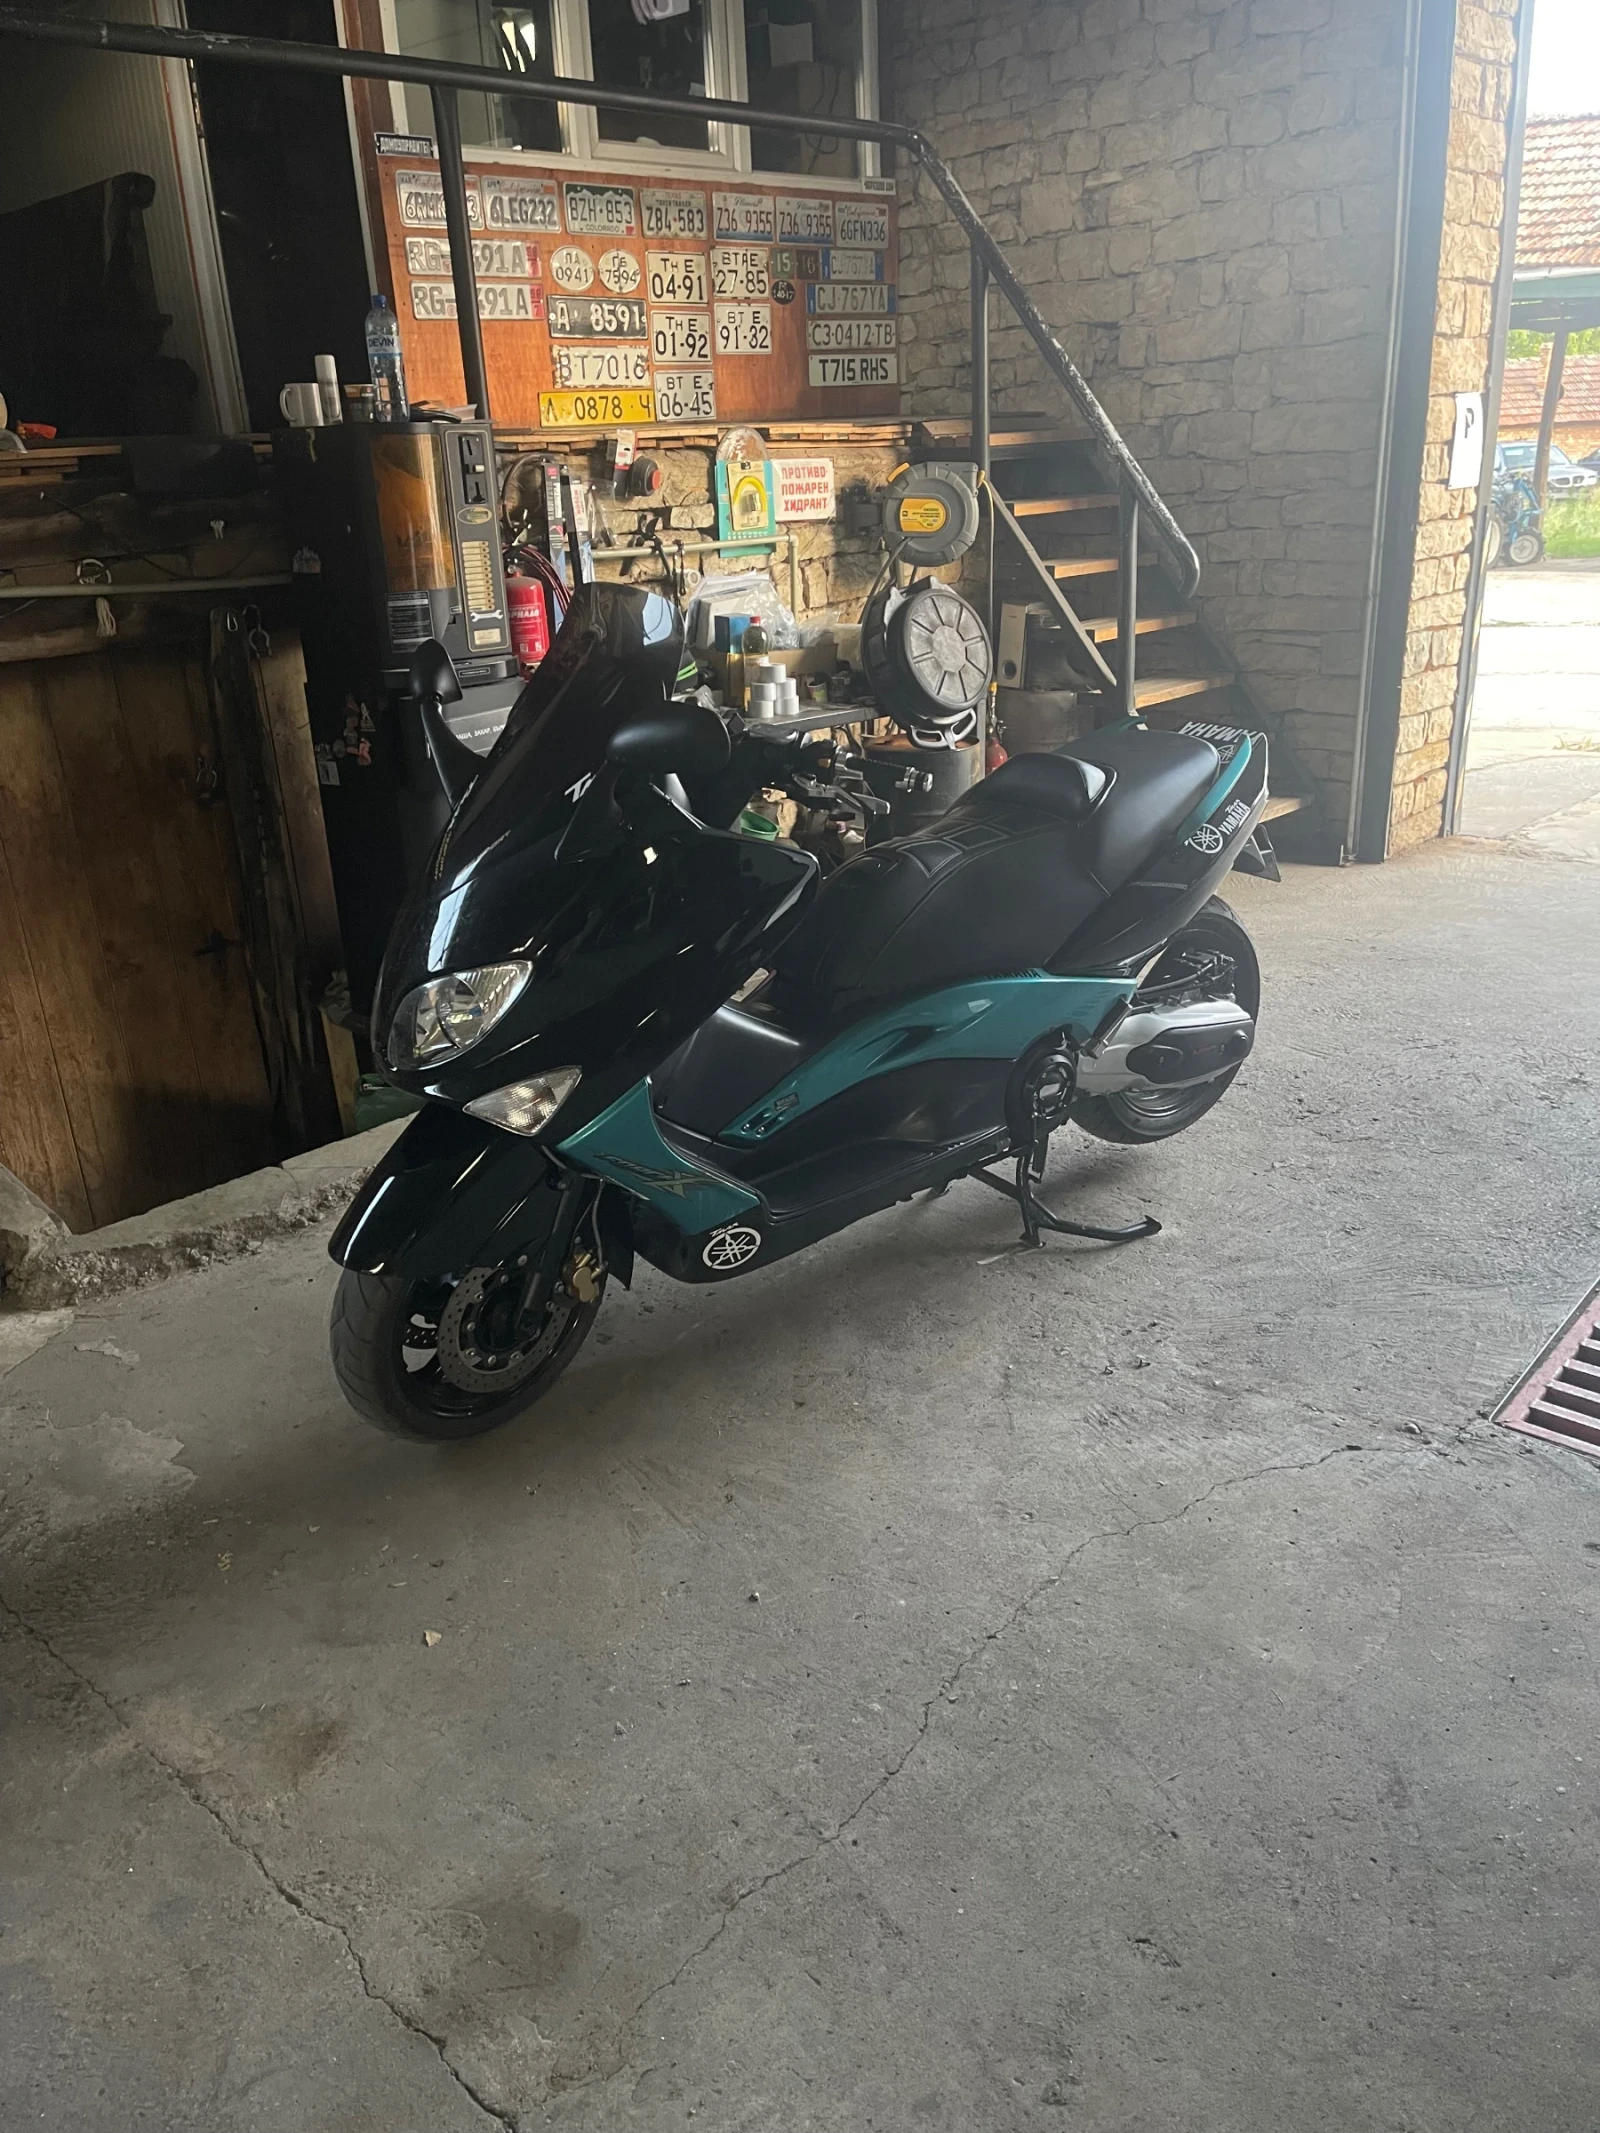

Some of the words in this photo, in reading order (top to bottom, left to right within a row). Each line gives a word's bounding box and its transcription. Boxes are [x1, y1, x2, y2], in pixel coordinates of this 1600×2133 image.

[490, 195, 557, 225] 6LEG232
[717, 207, 738, 231] Z36
[745, 209, 773, 235] 9355
[585, 223, 620, 233] COLORADO
[779, 211, 799, 235] Z36
[806, 213, 832, 237] 9355
[777, 253, 791, 272] 15
[555, 266, 589, 283] 0941
[590, 303, 640, 332] 8591
[368, 337, 395, 348] DEVIN
[861, 358, 889, 381] RHS
[574, 395, 623, 421] 0878
[781, 481, 829, 496] ПОЖАРЕН
[783, 497, 828, 513] ХИДРАНТ
[1218, 802, 1251, 835] YAMAHA
